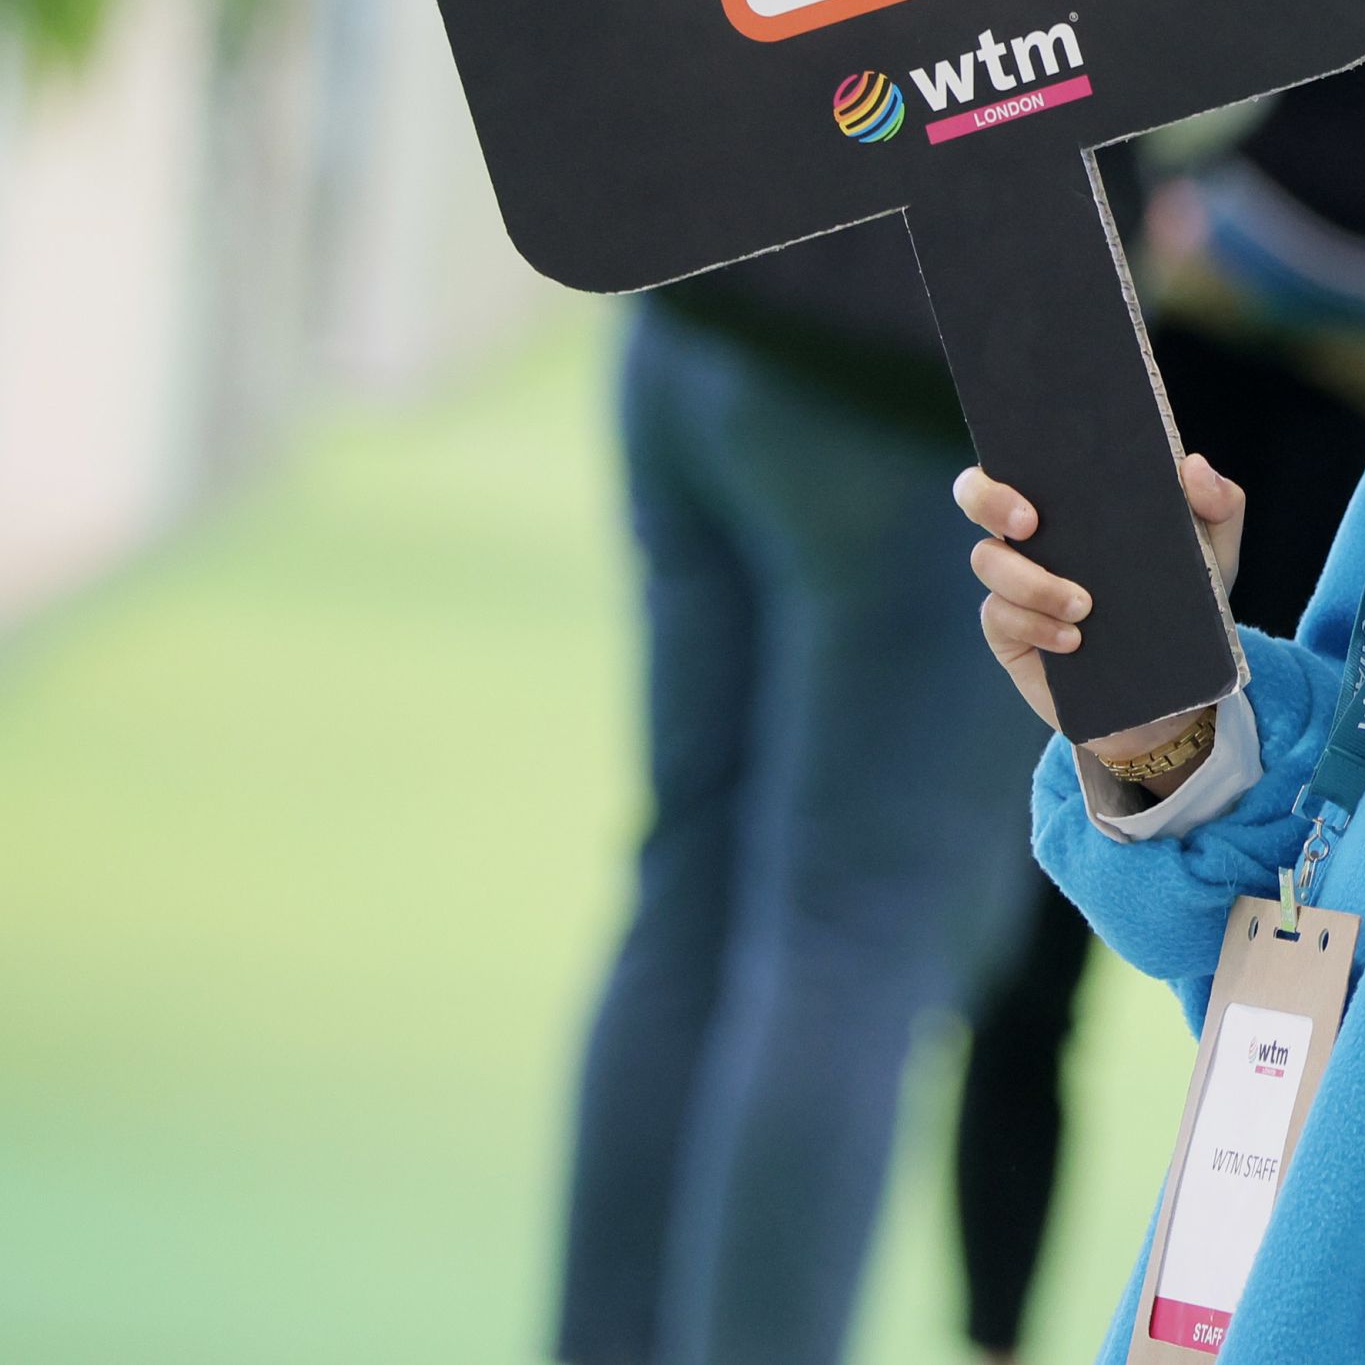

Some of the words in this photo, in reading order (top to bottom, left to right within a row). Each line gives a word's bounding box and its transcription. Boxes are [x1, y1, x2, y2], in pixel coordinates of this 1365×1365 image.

[909, 22, 1084, 112] wtm
[974, 93, 1045, 128] LONDON
[1259, 1040, 1289, 1066] wtm
[1212, 1148, 1245, 1175] WTM
[1243, 1154, 1278, 1182] STAFF
[1193, 1322, 1223, 1346] STAFF
